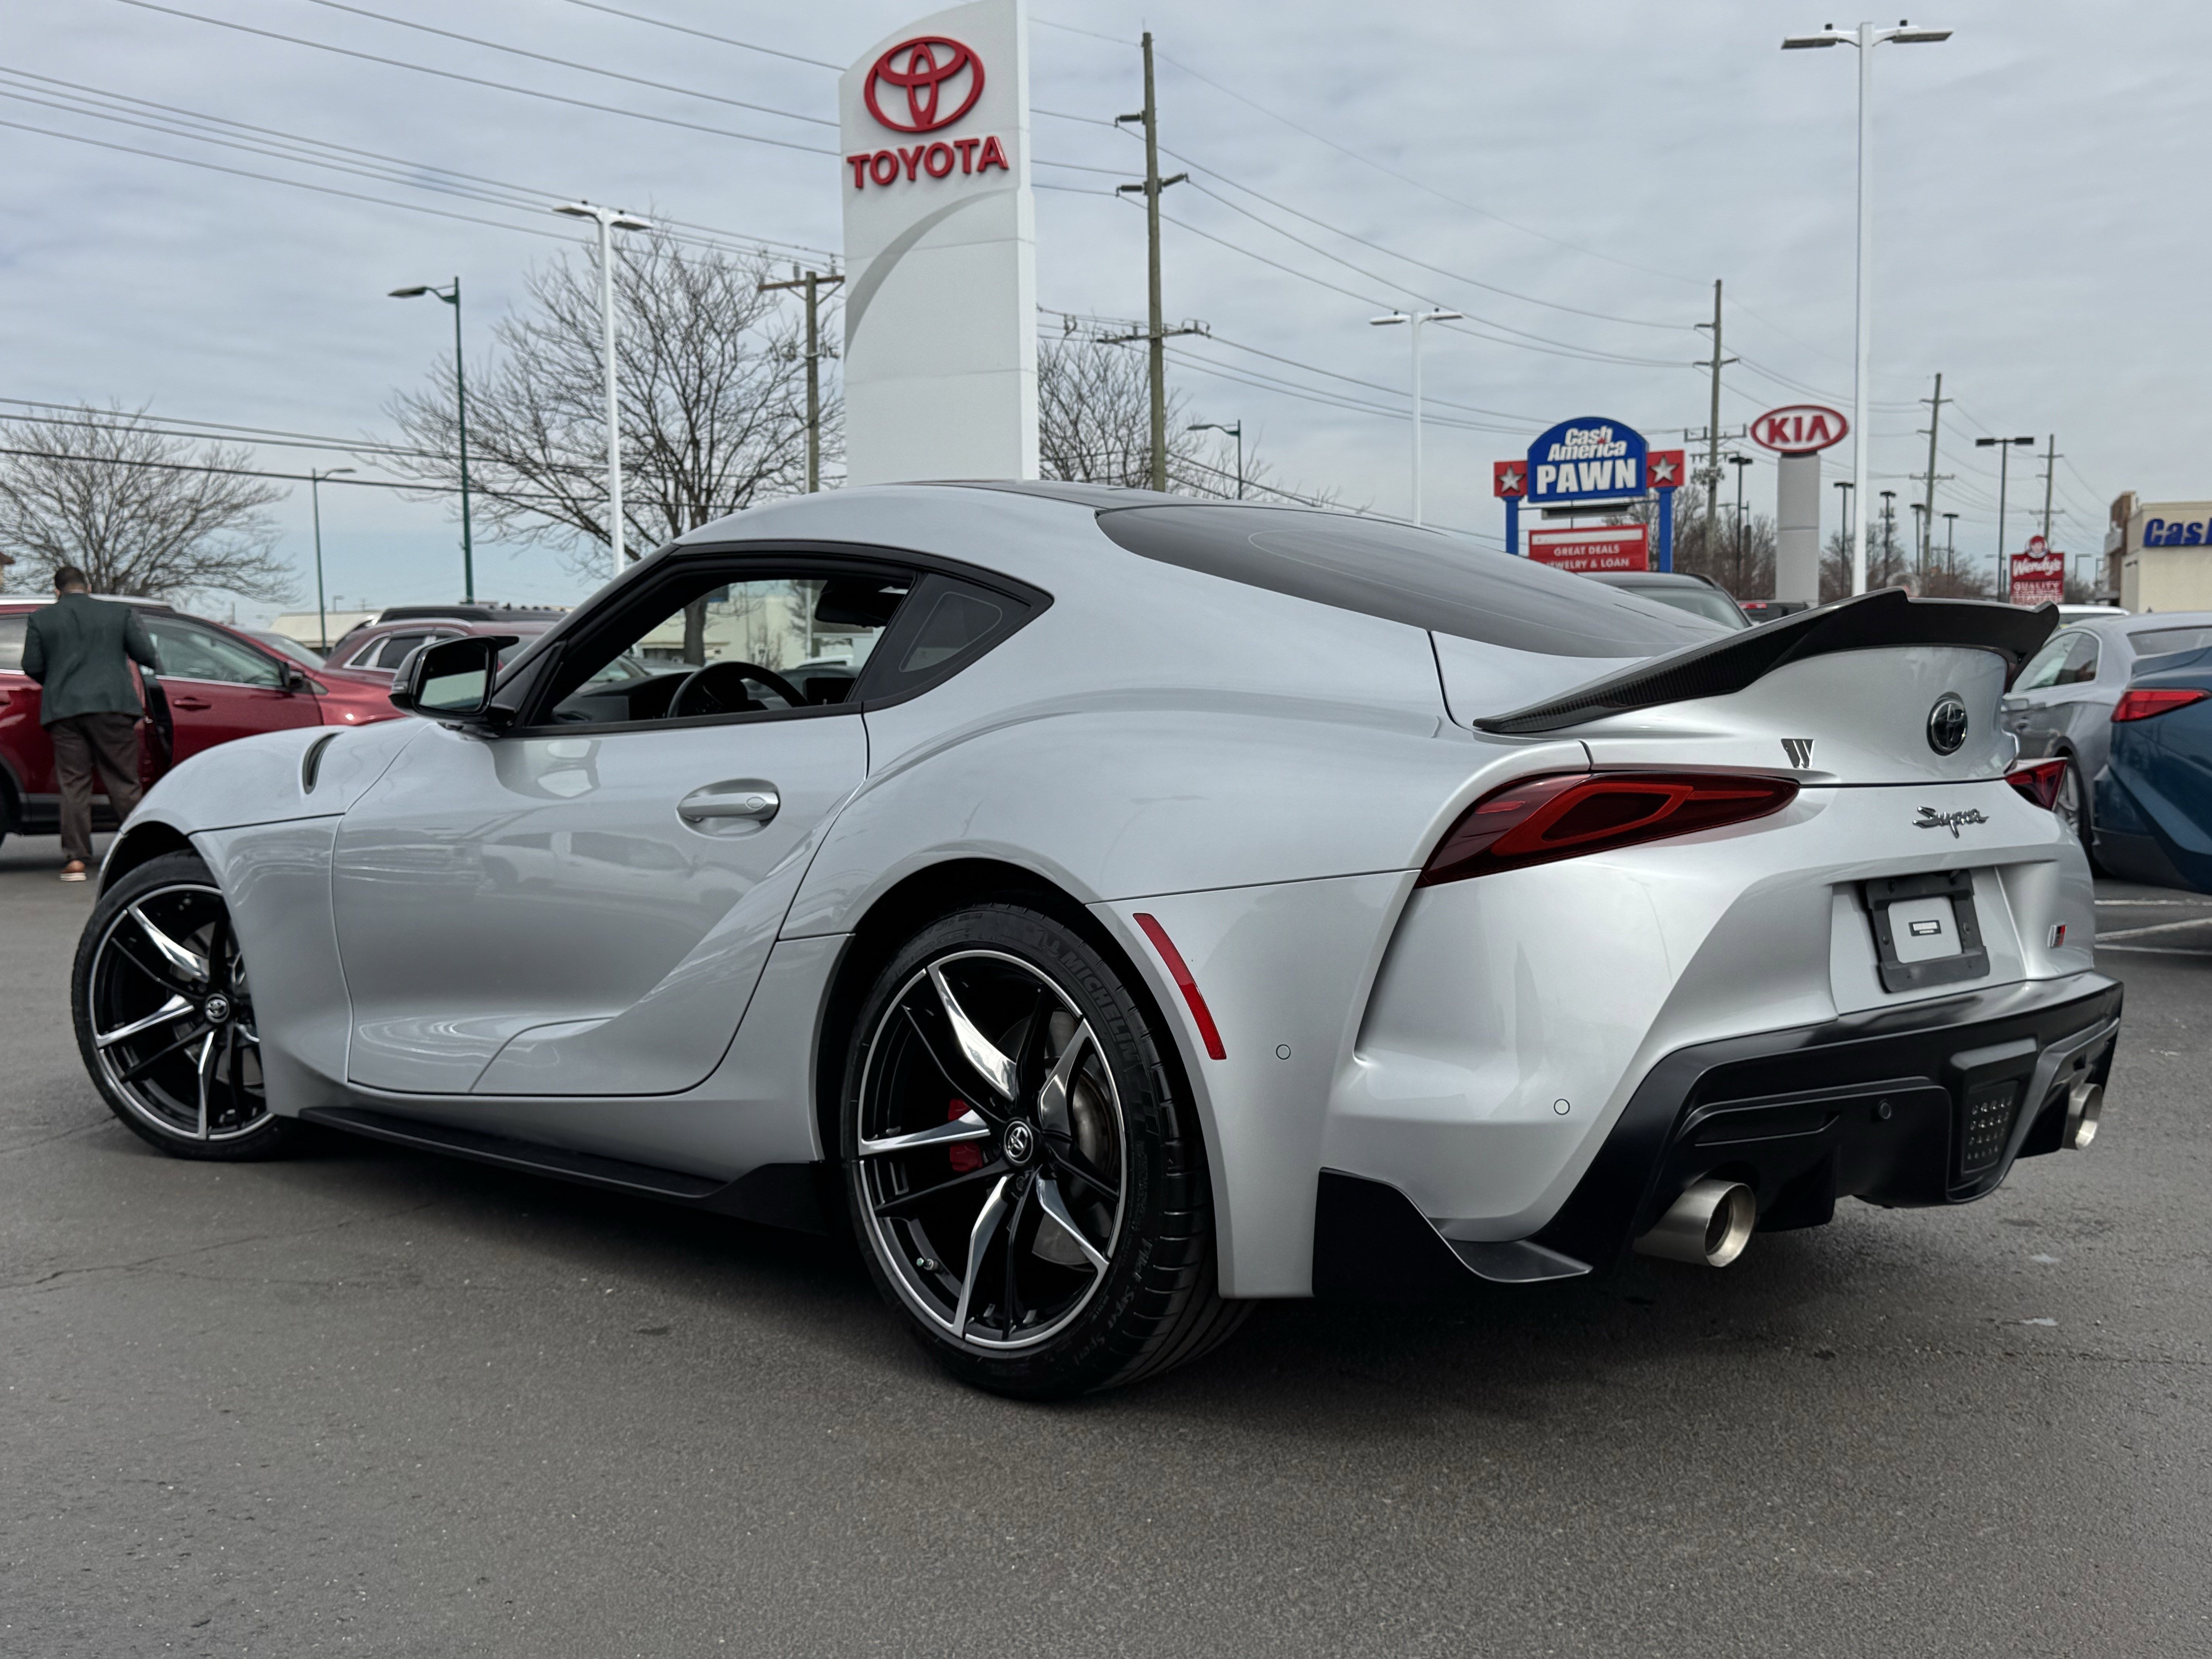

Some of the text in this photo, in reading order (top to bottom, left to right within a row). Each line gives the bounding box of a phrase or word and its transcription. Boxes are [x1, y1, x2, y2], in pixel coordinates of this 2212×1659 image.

[847, 136, 1009, 189] TOYOTA
[1565, 425, 1613, 446] Cash
[1767, 414, 1831, 444] KIA
[1547, 440, 1627, 461] America
[1537, 458, 1637, 495] PAWN
[1554, 544, 1620, 556] GREAT DEALS
[1590, 559, 1598, 568] &
[1601, 558, 1630, 568] LOAN
[2013, 555, 2061, 577] Wendy's
[1912, 806, 1989, 838] Supra
[1060, 951, 1142, 1064] MICHELIN
